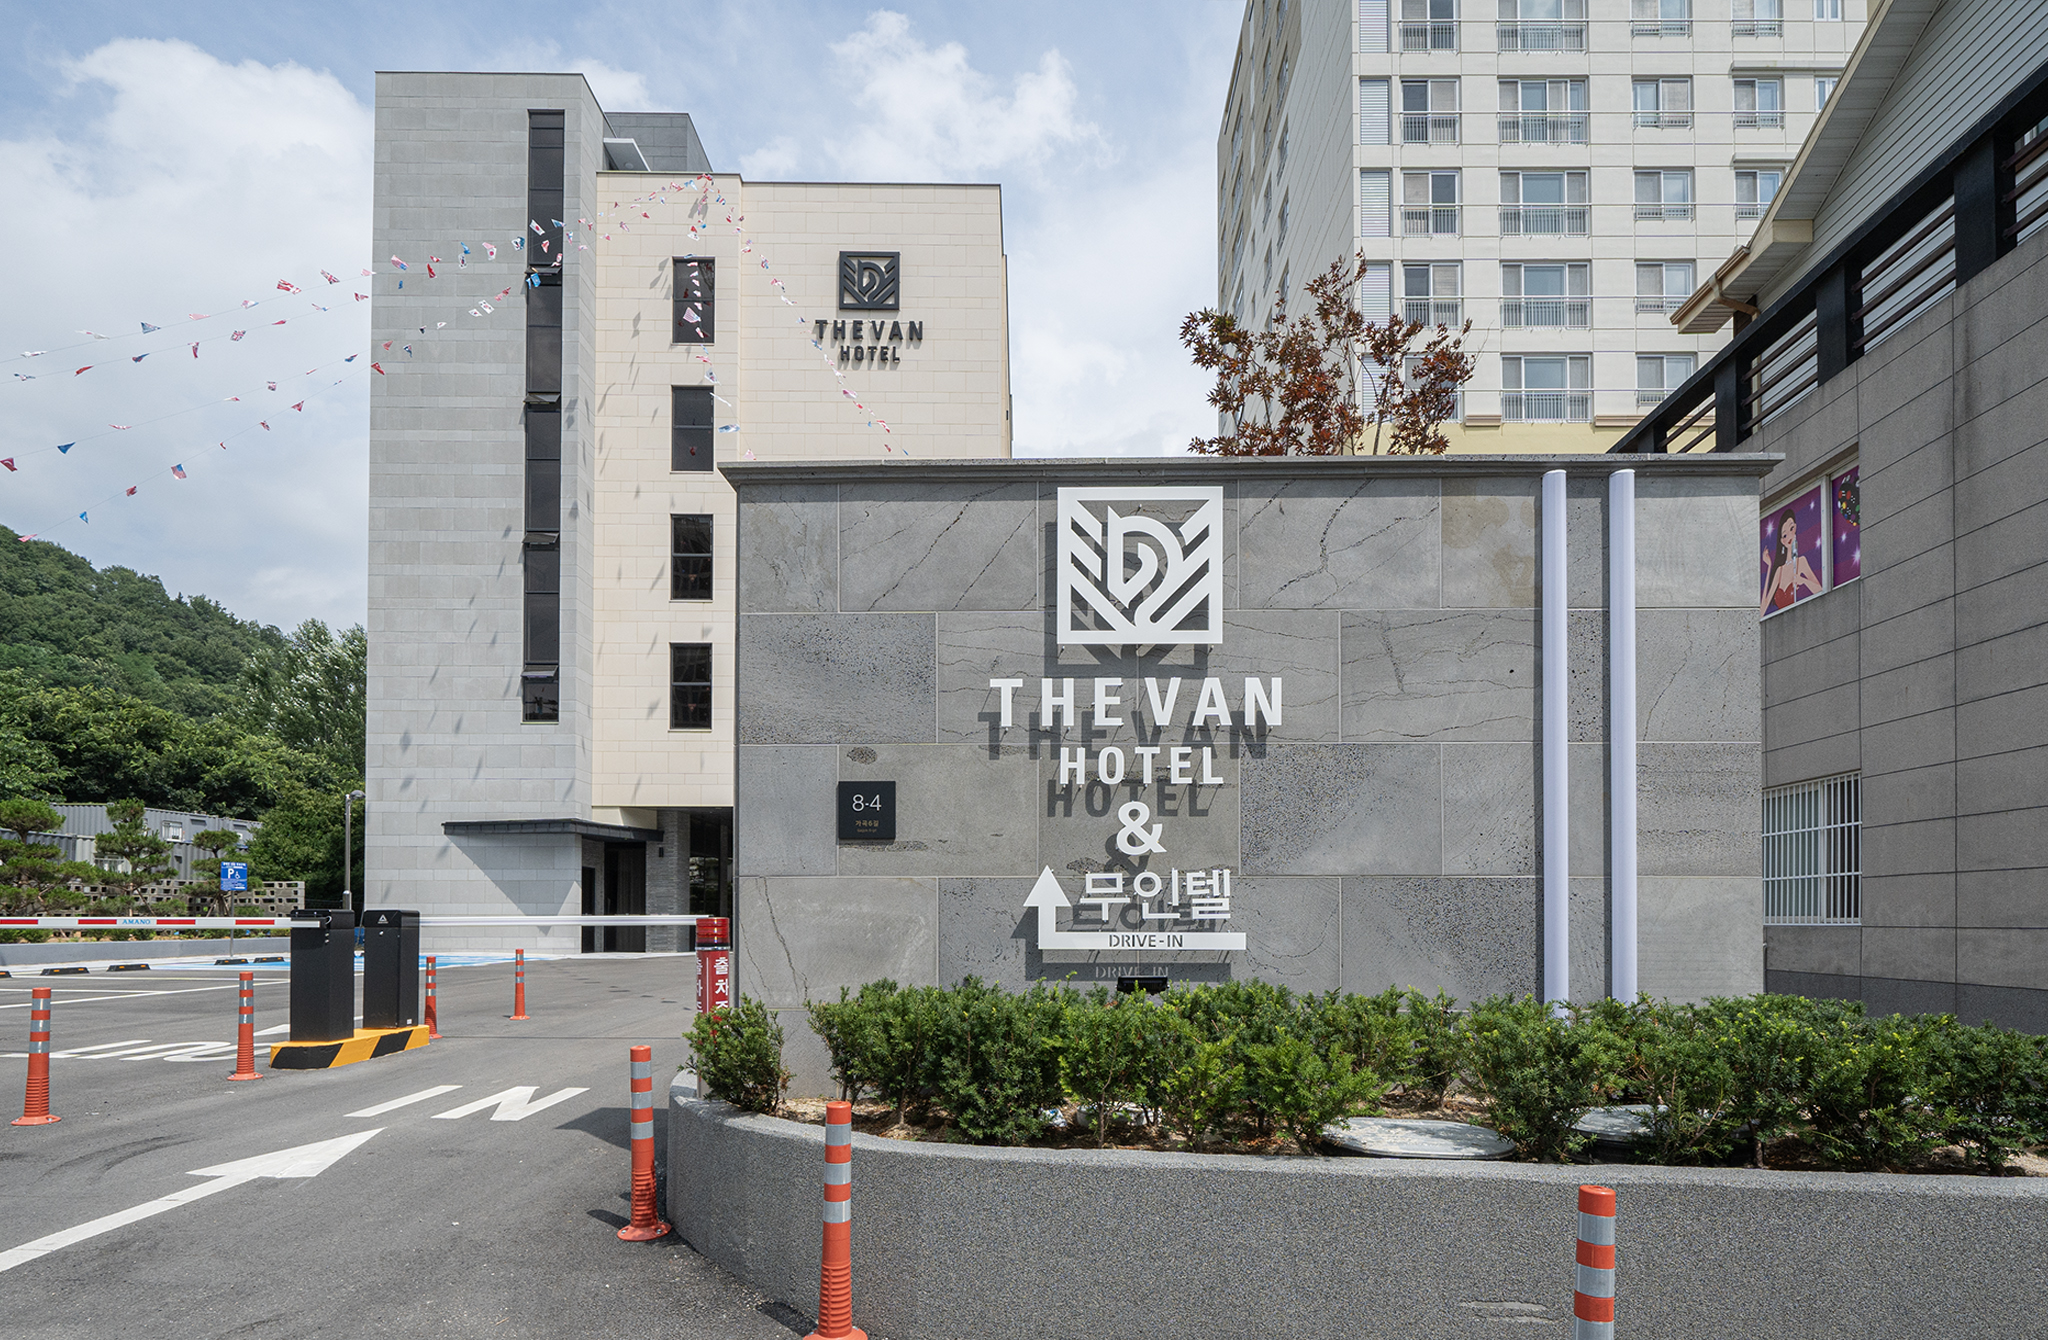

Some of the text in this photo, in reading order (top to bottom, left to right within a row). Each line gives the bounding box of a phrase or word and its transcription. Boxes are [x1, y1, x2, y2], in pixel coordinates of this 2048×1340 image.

[840, 345, 901, 362] HOTEL
[1059, 747, 1225, 785] HOTEL
[852, 794, 882, 812] 8-4
[1116, 801, 1167, 856] &
[227, 868, 235, 879] P
[1079, 868, 1232, 921] 무인텔
[1109, 934, 1183, 947] DRIVE-IN
[343, 1085, 591, 1121] IN
